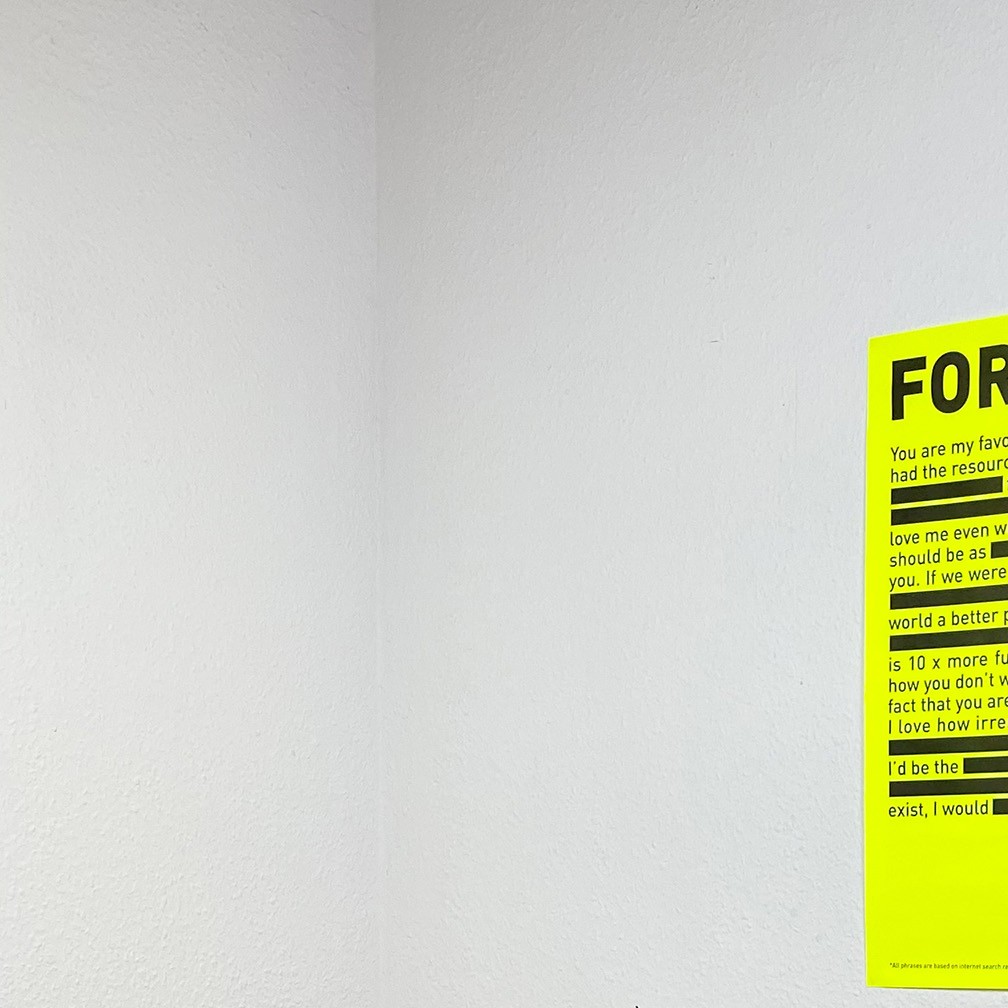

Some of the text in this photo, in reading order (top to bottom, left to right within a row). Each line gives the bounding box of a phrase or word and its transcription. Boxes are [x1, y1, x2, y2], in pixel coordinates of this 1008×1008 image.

[890, 446, 916, 462] You
[921, 444, 946, 459] are
[951, 440, 975, 457] my
[890, 465, 918, 483] had
[922, 463, 947, 480] the
[890, 531, 920, 547] love
[925, 530, 949, 543] me
[953, 525, 989, 540] even
[889, 548, 941, 568] should
[946, 547, 964, 563] be
[969, 547, 987, 561] as
[888, 575, 920, 593] you.
[926, 569, 937, 586] If
[941, 571, 963, 584] we
[968, 567, 1007, 582] were
[888, 612, 933, 630] world
[937, 615, 946, 627] a
[951, 609, 999, 626] better
[889, 657, 901, 672] is
[909, 655, 926, 671] 10
[932, 658, 941, 670] x
[947, 655, 988, 669] more
[888, 678, 920, 693] how
[924, 678, 950, 695] you
[955, 672, 994, 689] don't
[888, 698, 916, 714] fact
[921, 696, 951, 712] that
[955, 698, 982, 715] you
[888, 719, 892, 735] I
[898, 719, 931, 734] love
[937, 717, 970, 732] how
[888, 760, 906, 776] I'd
[911, 760, 930, 776] be
[934, 759, 959, 775] the
[888, 799, 989, 819] exist, I would
[900, 962, 923, 970] phrases
